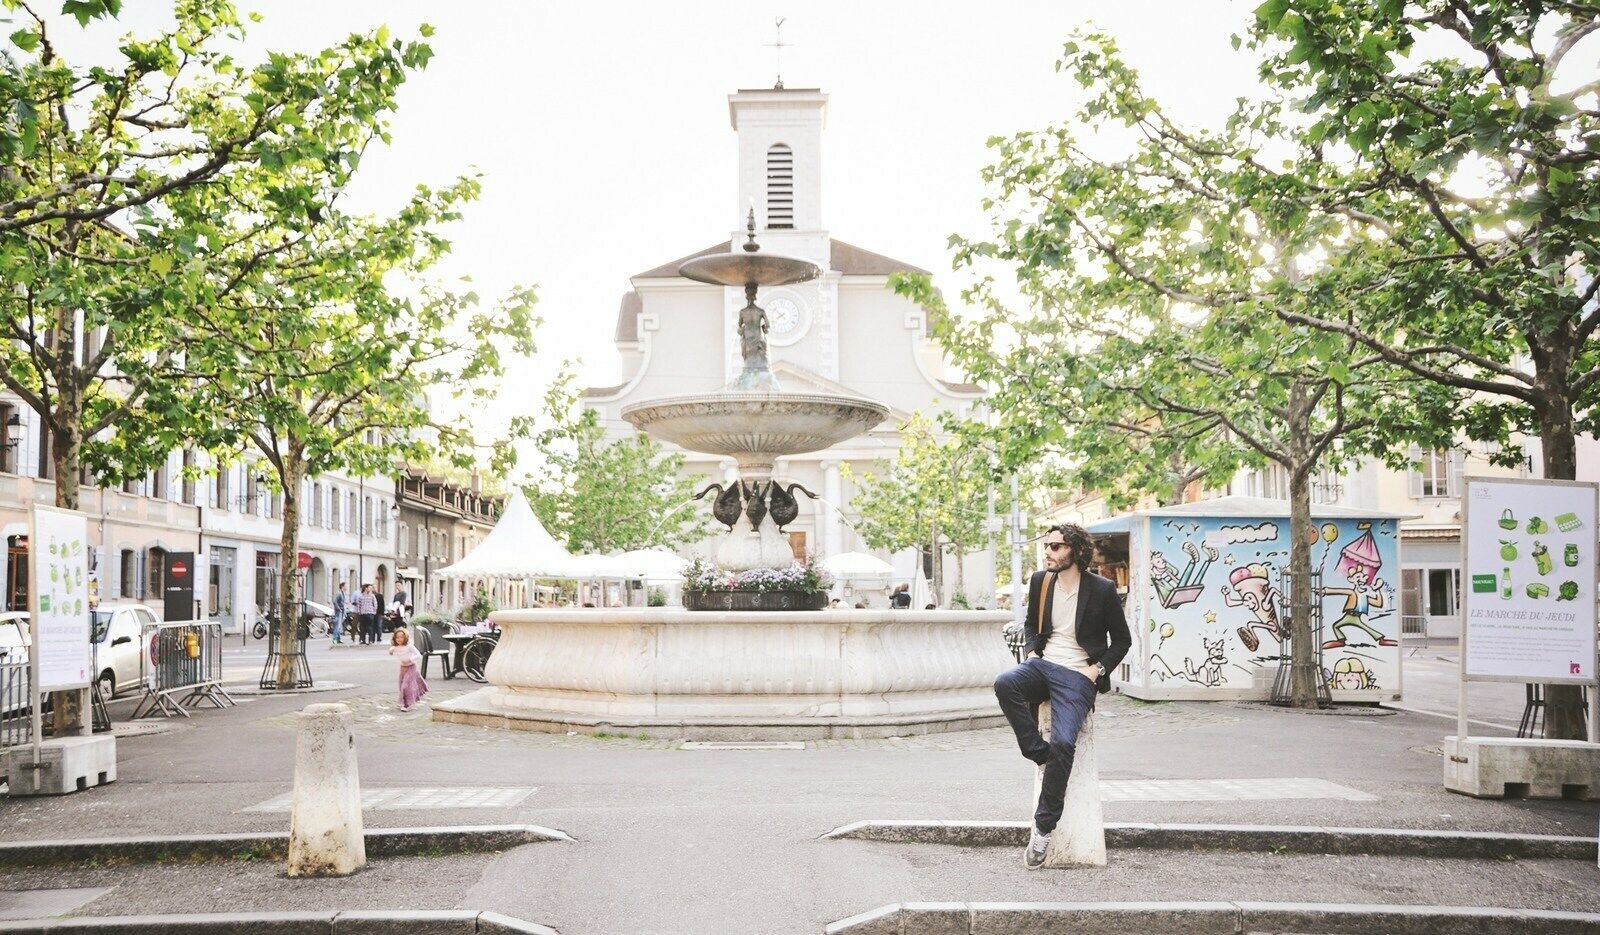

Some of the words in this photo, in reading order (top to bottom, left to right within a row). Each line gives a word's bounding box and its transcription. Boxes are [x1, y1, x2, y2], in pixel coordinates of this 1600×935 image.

[1470, 609, 1483, 618] LE
[1529, 611, 1545, 621] DU
[1546, 611, 1576, 622] JEUDI
